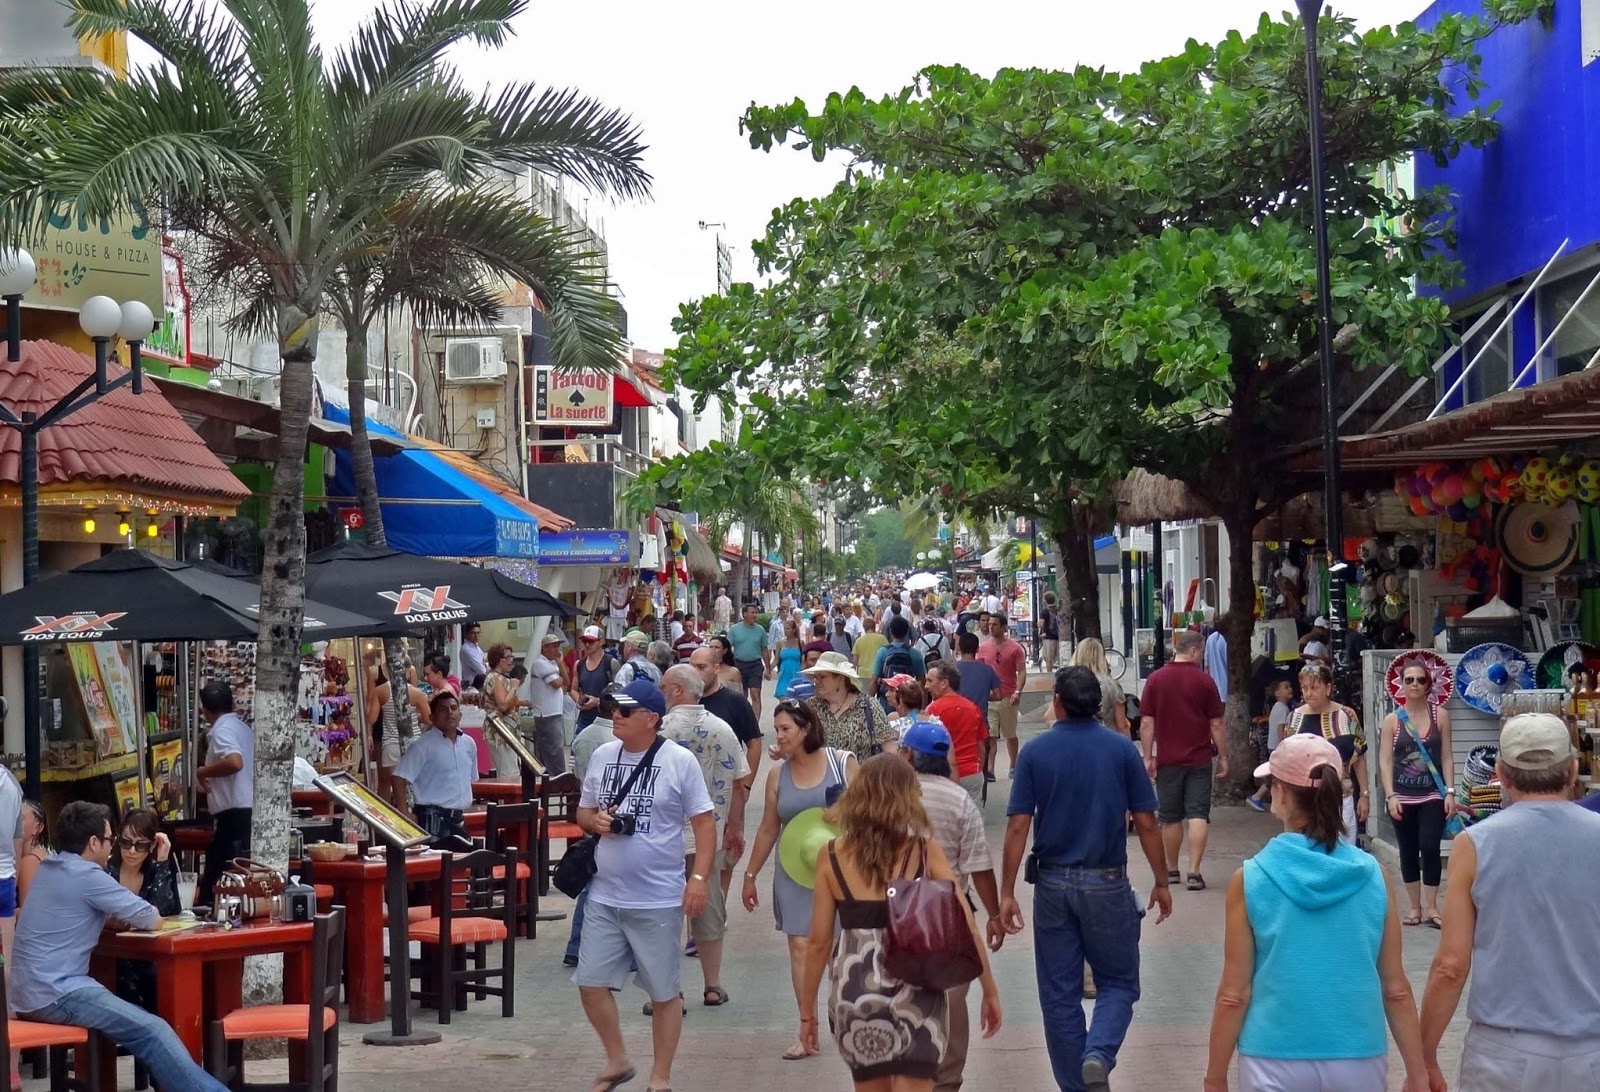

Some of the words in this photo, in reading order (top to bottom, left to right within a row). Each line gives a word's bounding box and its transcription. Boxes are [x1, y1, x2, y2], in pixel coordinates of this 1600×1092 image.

[56, 240, 97, 258] HOUSE
[103, 246, 111, 259] &
[117, 248, 150, 264] PIZZA
[550, 371, 607, 391] Tattoo
[550, 403, 563, 419] La
[566, 405, 606, 419] suerte
[570, 548, 613, 556] cambiario
[1027, 561, 1046, 569] AM
[404, 614, 431, 623] DOS
[431, 609, 468, 621] EQUIS
[23, 633, 56, 641] DOS
[58, 631, 103, 640] EQUIS
[600, 766, 627, 793] NEW
[626, 798, 653, 814] 1962
